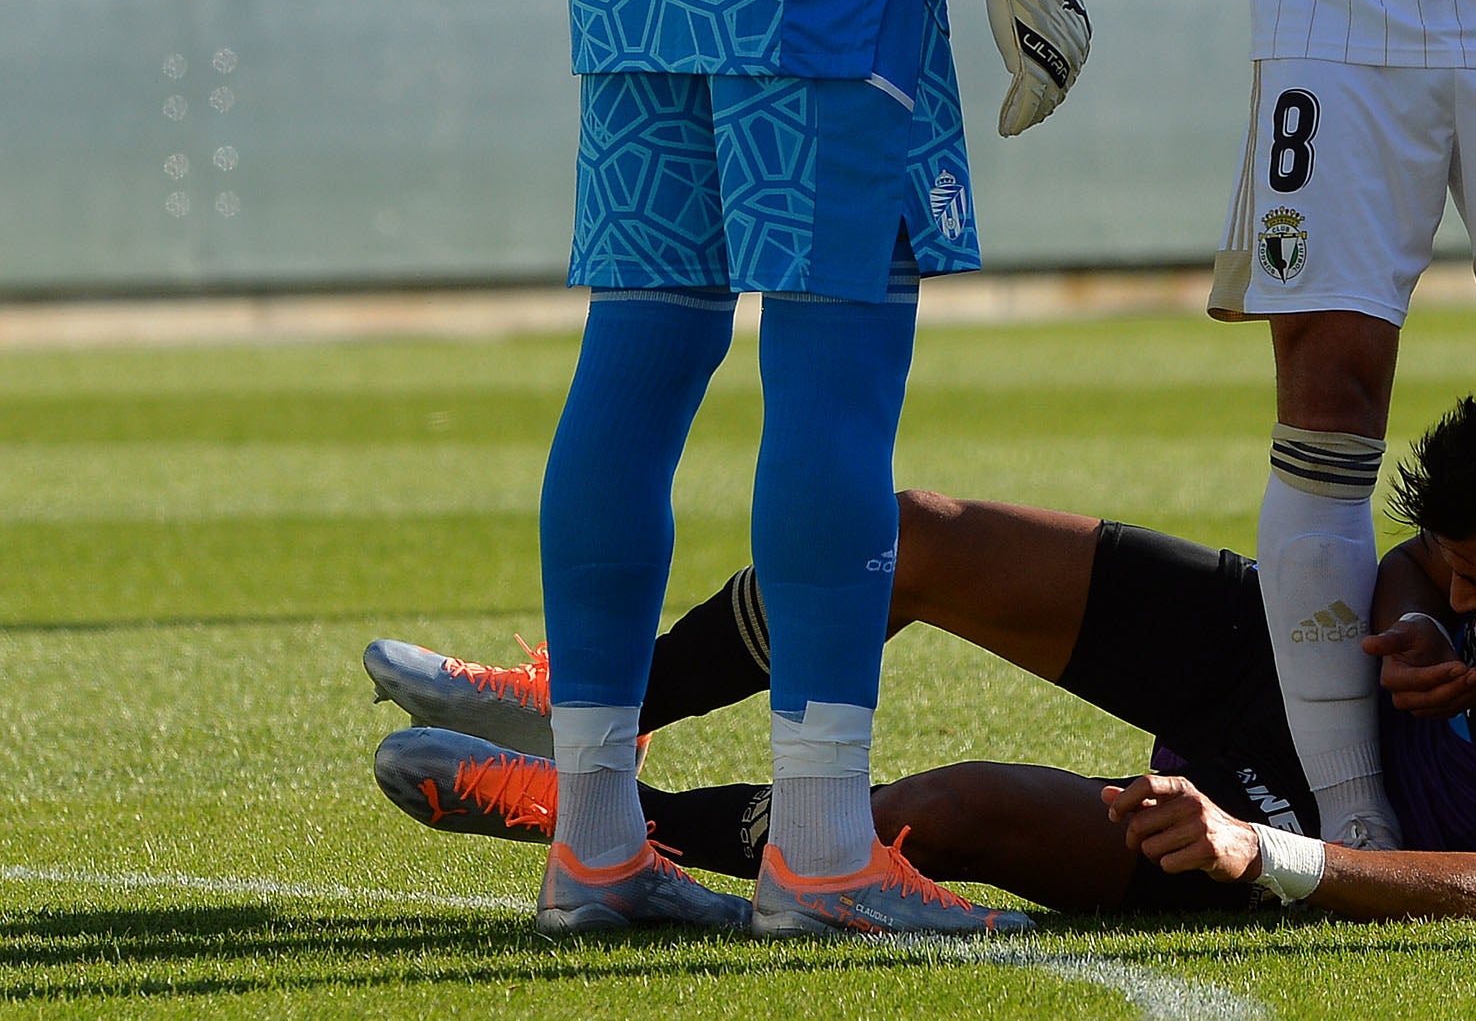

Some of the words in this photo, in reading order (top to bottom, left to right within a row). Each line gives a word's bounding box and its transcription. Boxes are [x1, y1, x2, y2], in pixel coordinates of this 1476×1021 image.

[1023, 33, 1068, 85] ULTRA
[1271, 89, 1319, 192] 8
[1292, 620, 1369, 643] adidas
[740, 785, 770, 859] didas
[1245, 785, 1304, 835] INE
[796, 891, 888, 932] ULTR
[856, 903, 889, 921] CLAUDIA
